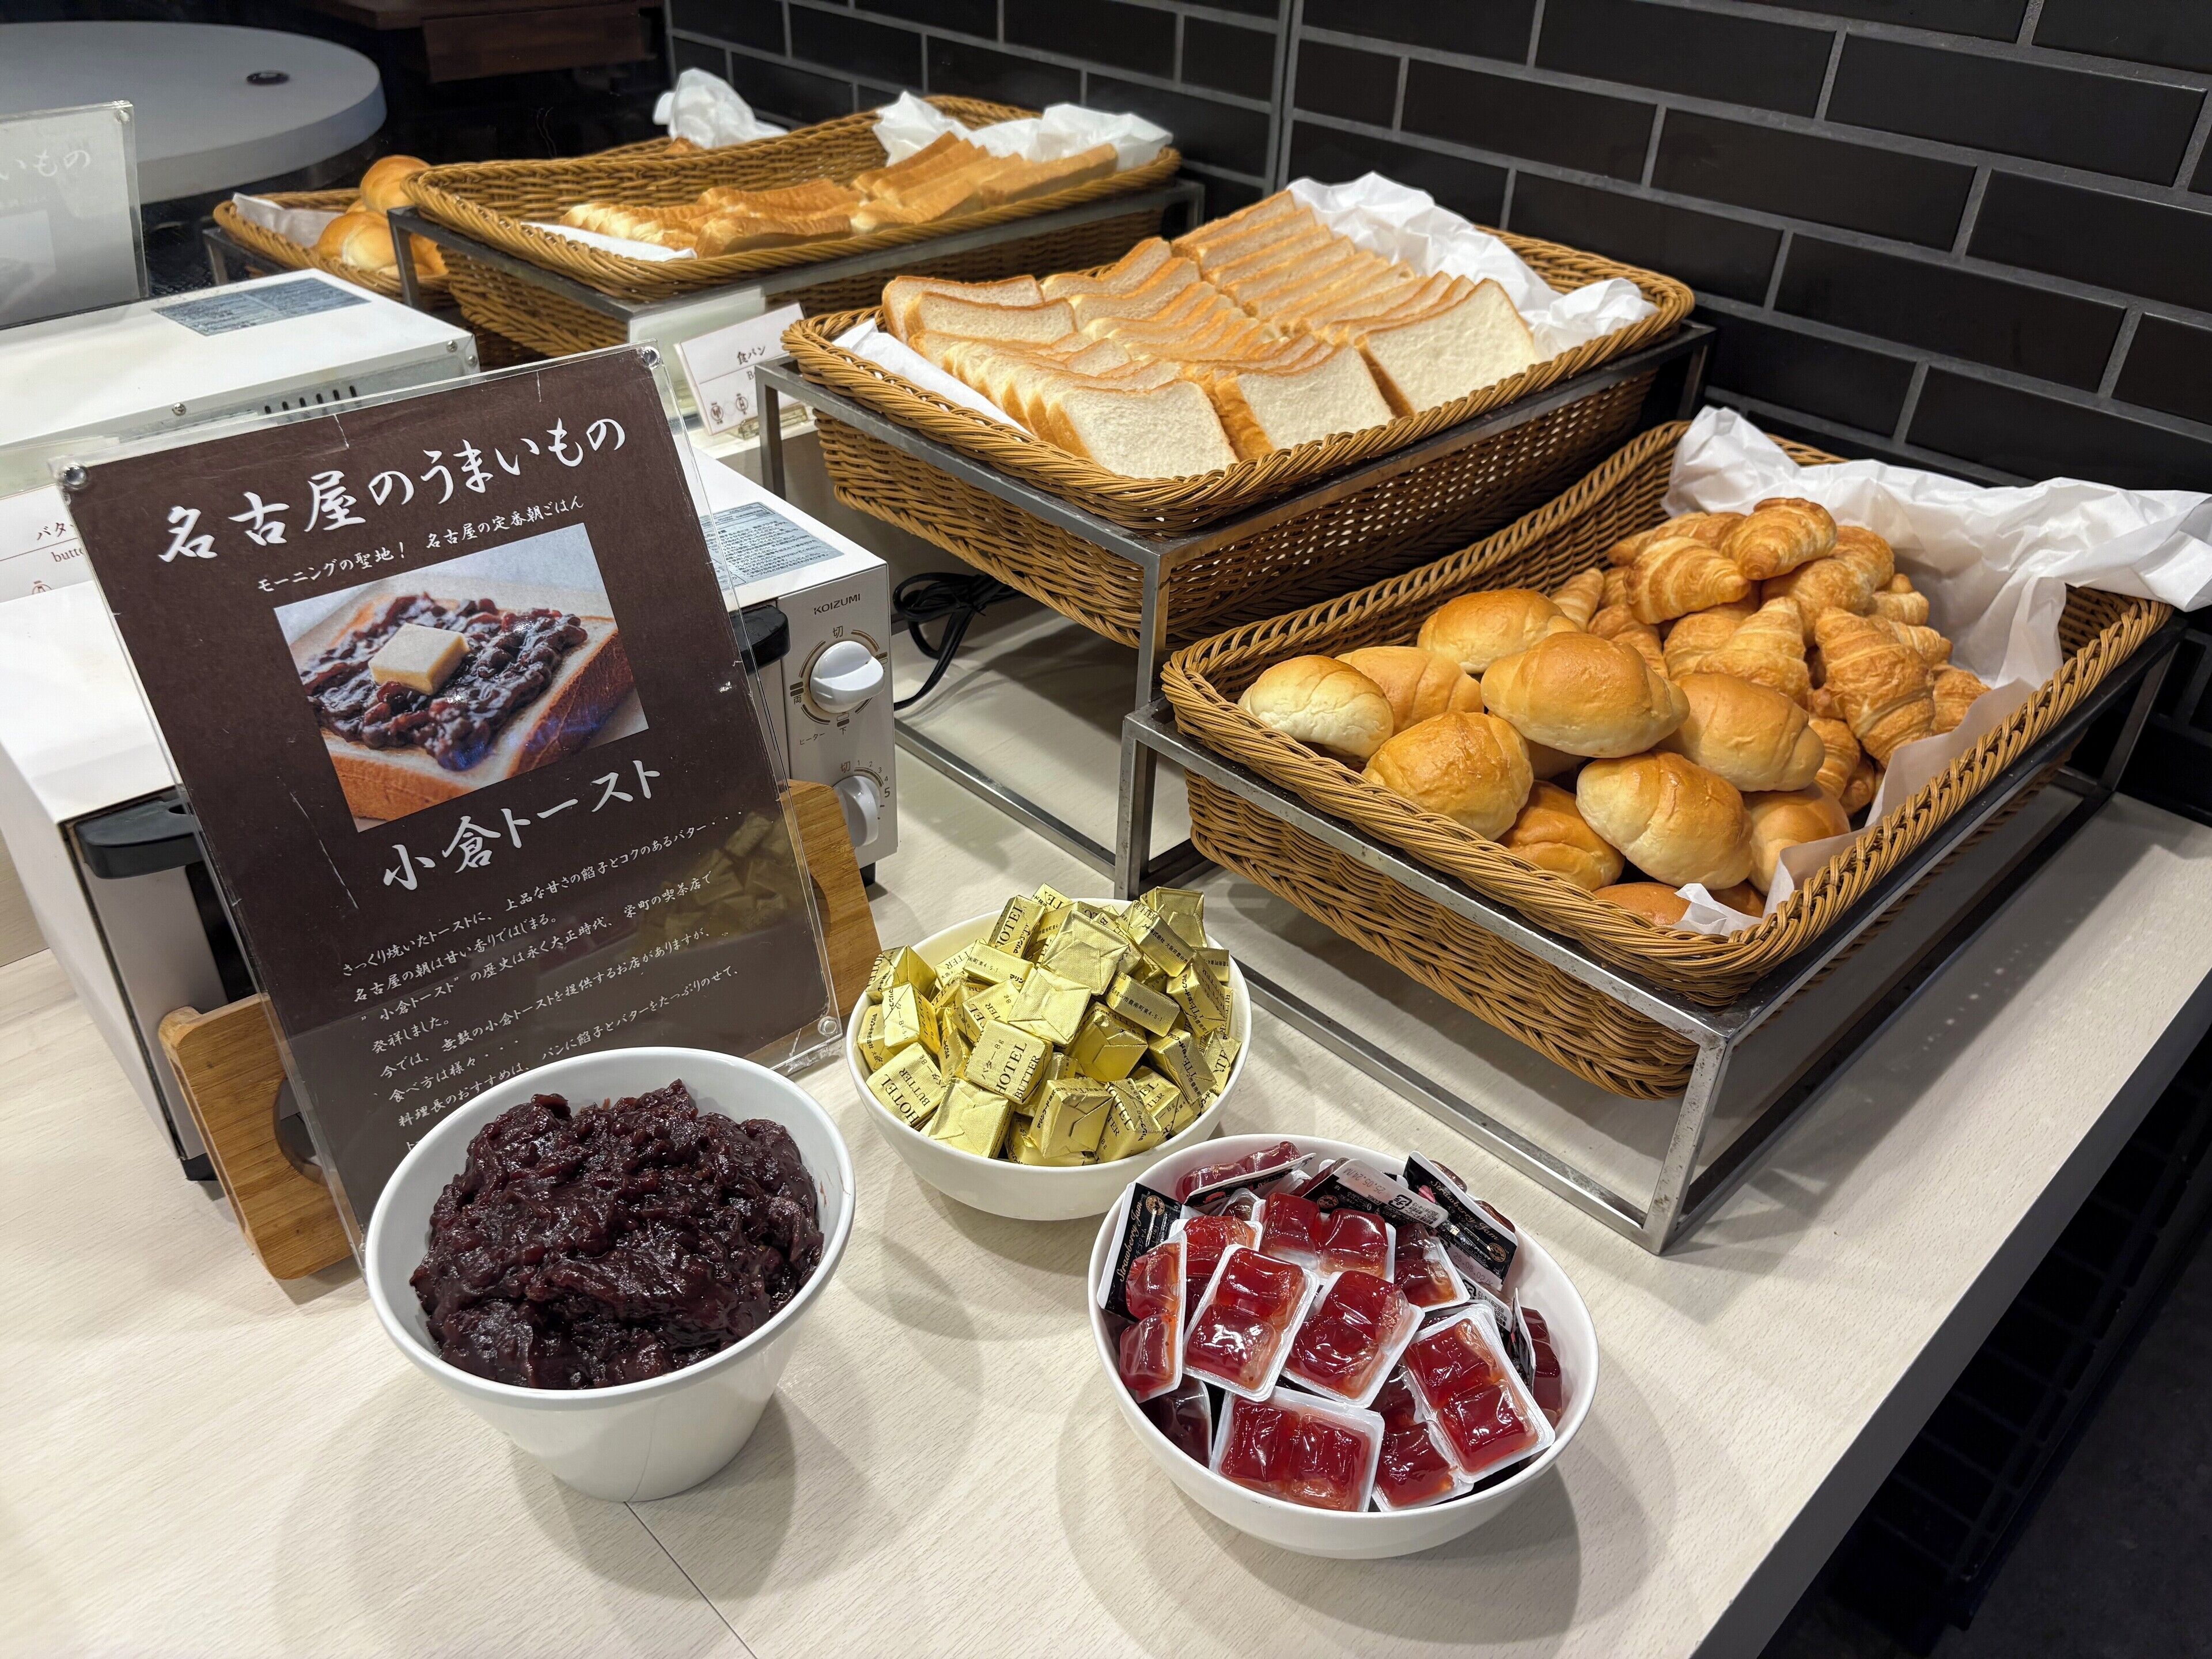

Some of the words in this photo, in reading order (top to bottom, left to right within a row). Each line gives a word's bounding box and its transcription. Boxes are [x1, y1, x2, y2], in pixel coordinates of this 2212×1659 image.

[737, 345, 766, 365] 食パン
[158, 418, 626, 563] 名古屋のうまいもの
[257, 542, 405, 592] モーニングの聖地！
[426, 495, 584, 548] 名古屋の定番朝ごはん
[813, 593, 861, 615] KOIZUMI
[832, 626, 843, 638] 切
[793, 694, 802, 704] 両
[799, 732, 825, 745] ヒーター
[839, 727, 847, 735] 下
[840, 760, 851, 773] 切
[884, 787, 891, 798] 5
[383, 760, 660, 890] 小倉トースト
[354, 914, 556, 1002] 名古屋の朝は甘い香りではじまる。
[372, 1017, 449, 1054] 発祥しました。
[995, 1042, 1028, 1094] HOTEL
[1014, 1055, 1040, 1100] BUTTER
[881, 1074, 921, 1125] HOTEL
[899, 1067, 931, 1107] BUTTER
[1116, 1224, 1140, 1282] Strawberry
[1131, 1200, 1143, 1226] Jam
[1474, 1221, 1499, 1241] Jam
